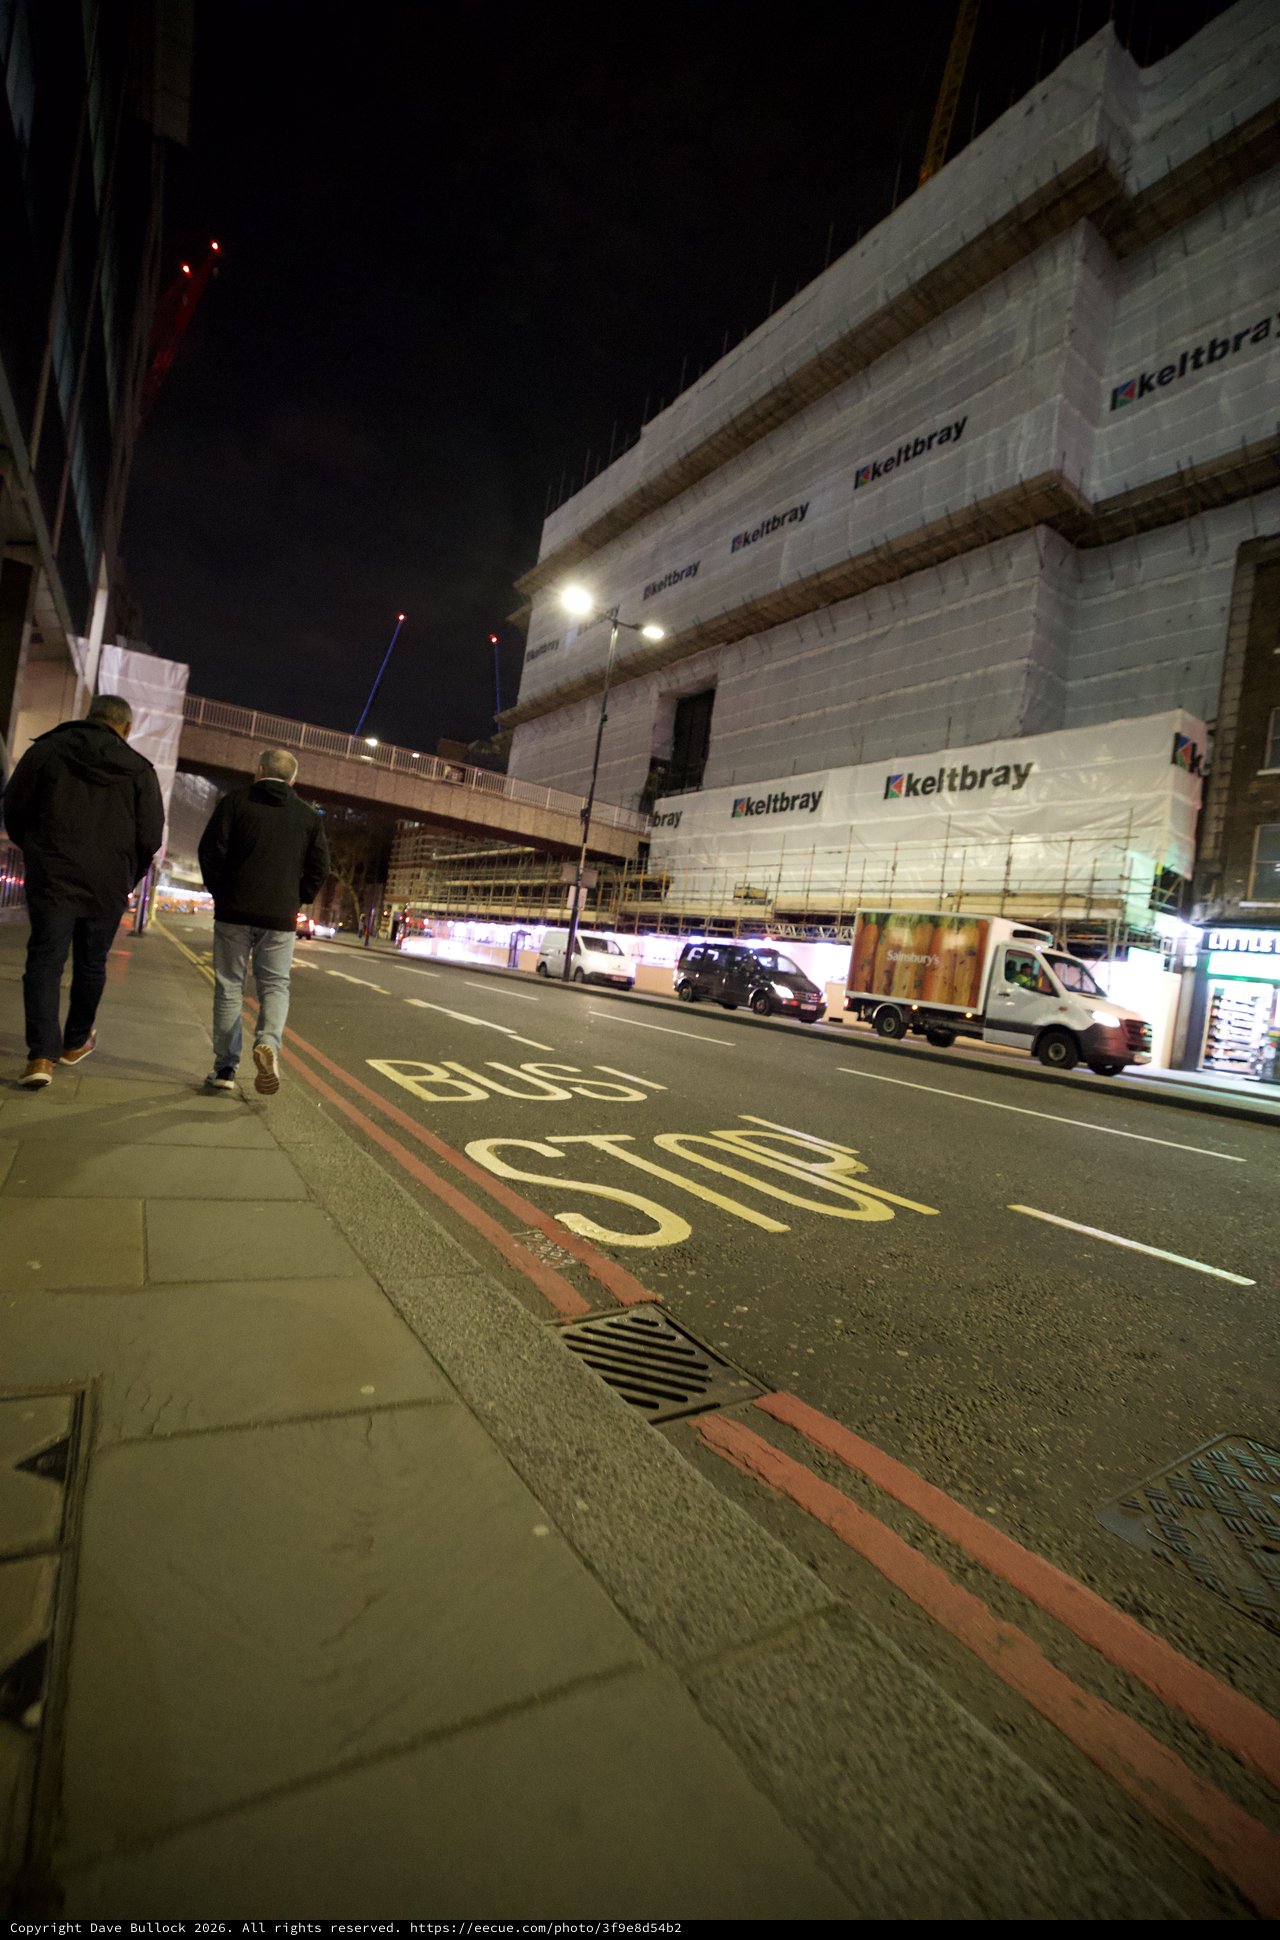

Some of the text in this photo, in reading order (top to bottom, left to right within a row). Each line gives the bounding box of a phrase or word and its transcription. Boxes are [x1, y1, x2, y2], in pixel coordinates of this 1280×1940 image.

[1137, 311, 1280, 399] keltbra
[871, 415, 968, 481] keltbray
[742, 502, 809, 548] keltbray
[652, 561, 700, 596] keltbray
[904, 762, 1034, 798] keltbray
[652, 810, 683, 829] bray
[744, 790, 823, 816] keltbray
[886, 949, 940, 967] Sainsbury's
[1208, 932, 1273, 952] LITTLE
[365, 1059, 648, 1102] BUS
[464, 1130, 940, 1248] STOP
